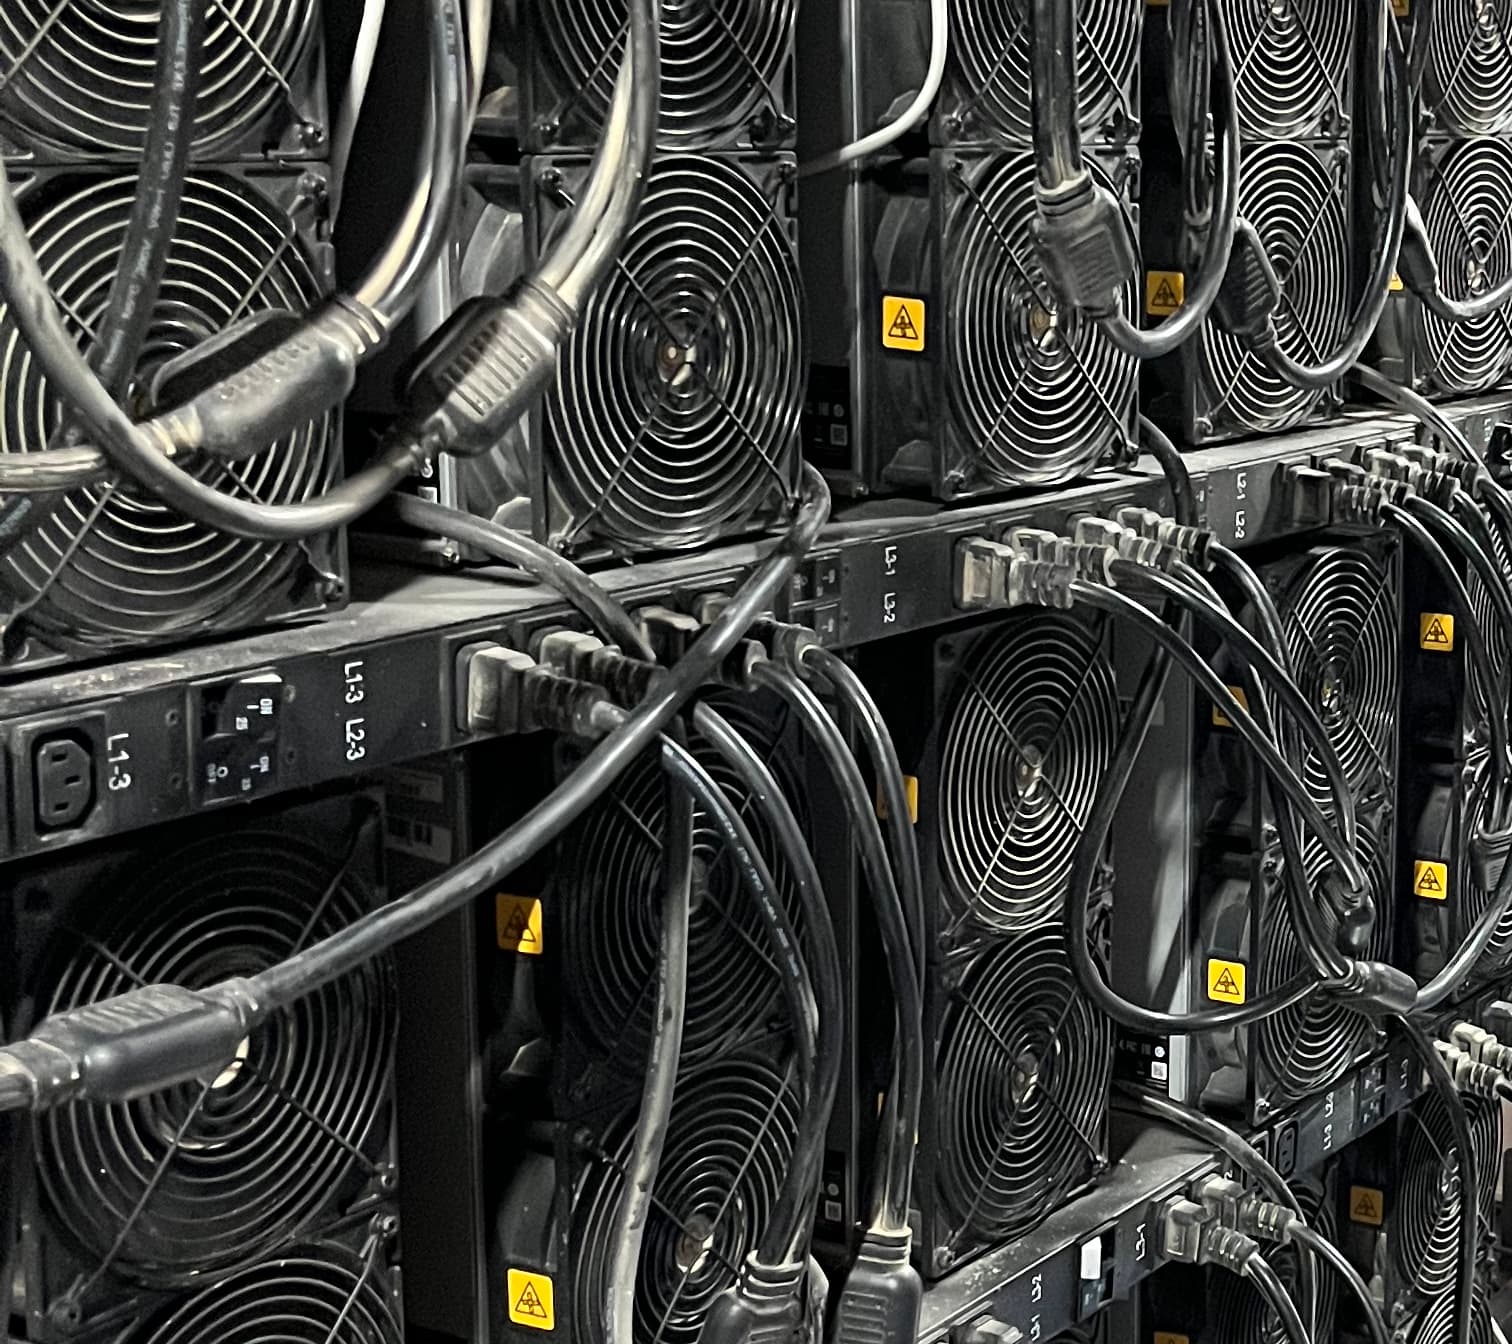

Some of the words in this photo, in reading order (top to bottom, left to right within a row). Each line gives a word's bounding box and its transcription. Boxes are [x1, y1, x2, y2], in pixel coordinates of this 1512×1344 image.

[1236, 472, 1247, 500] L2-1
[1234, 510, 1246, 539] L2-2
[884, 545, 897, 576] L3-1
[883, 591, 896, 624] L3-2
[344, 660, 365, 704] L1-3
[345, 717, 366, 761] L2-3
[107, 732, 132, 791] L1-3
